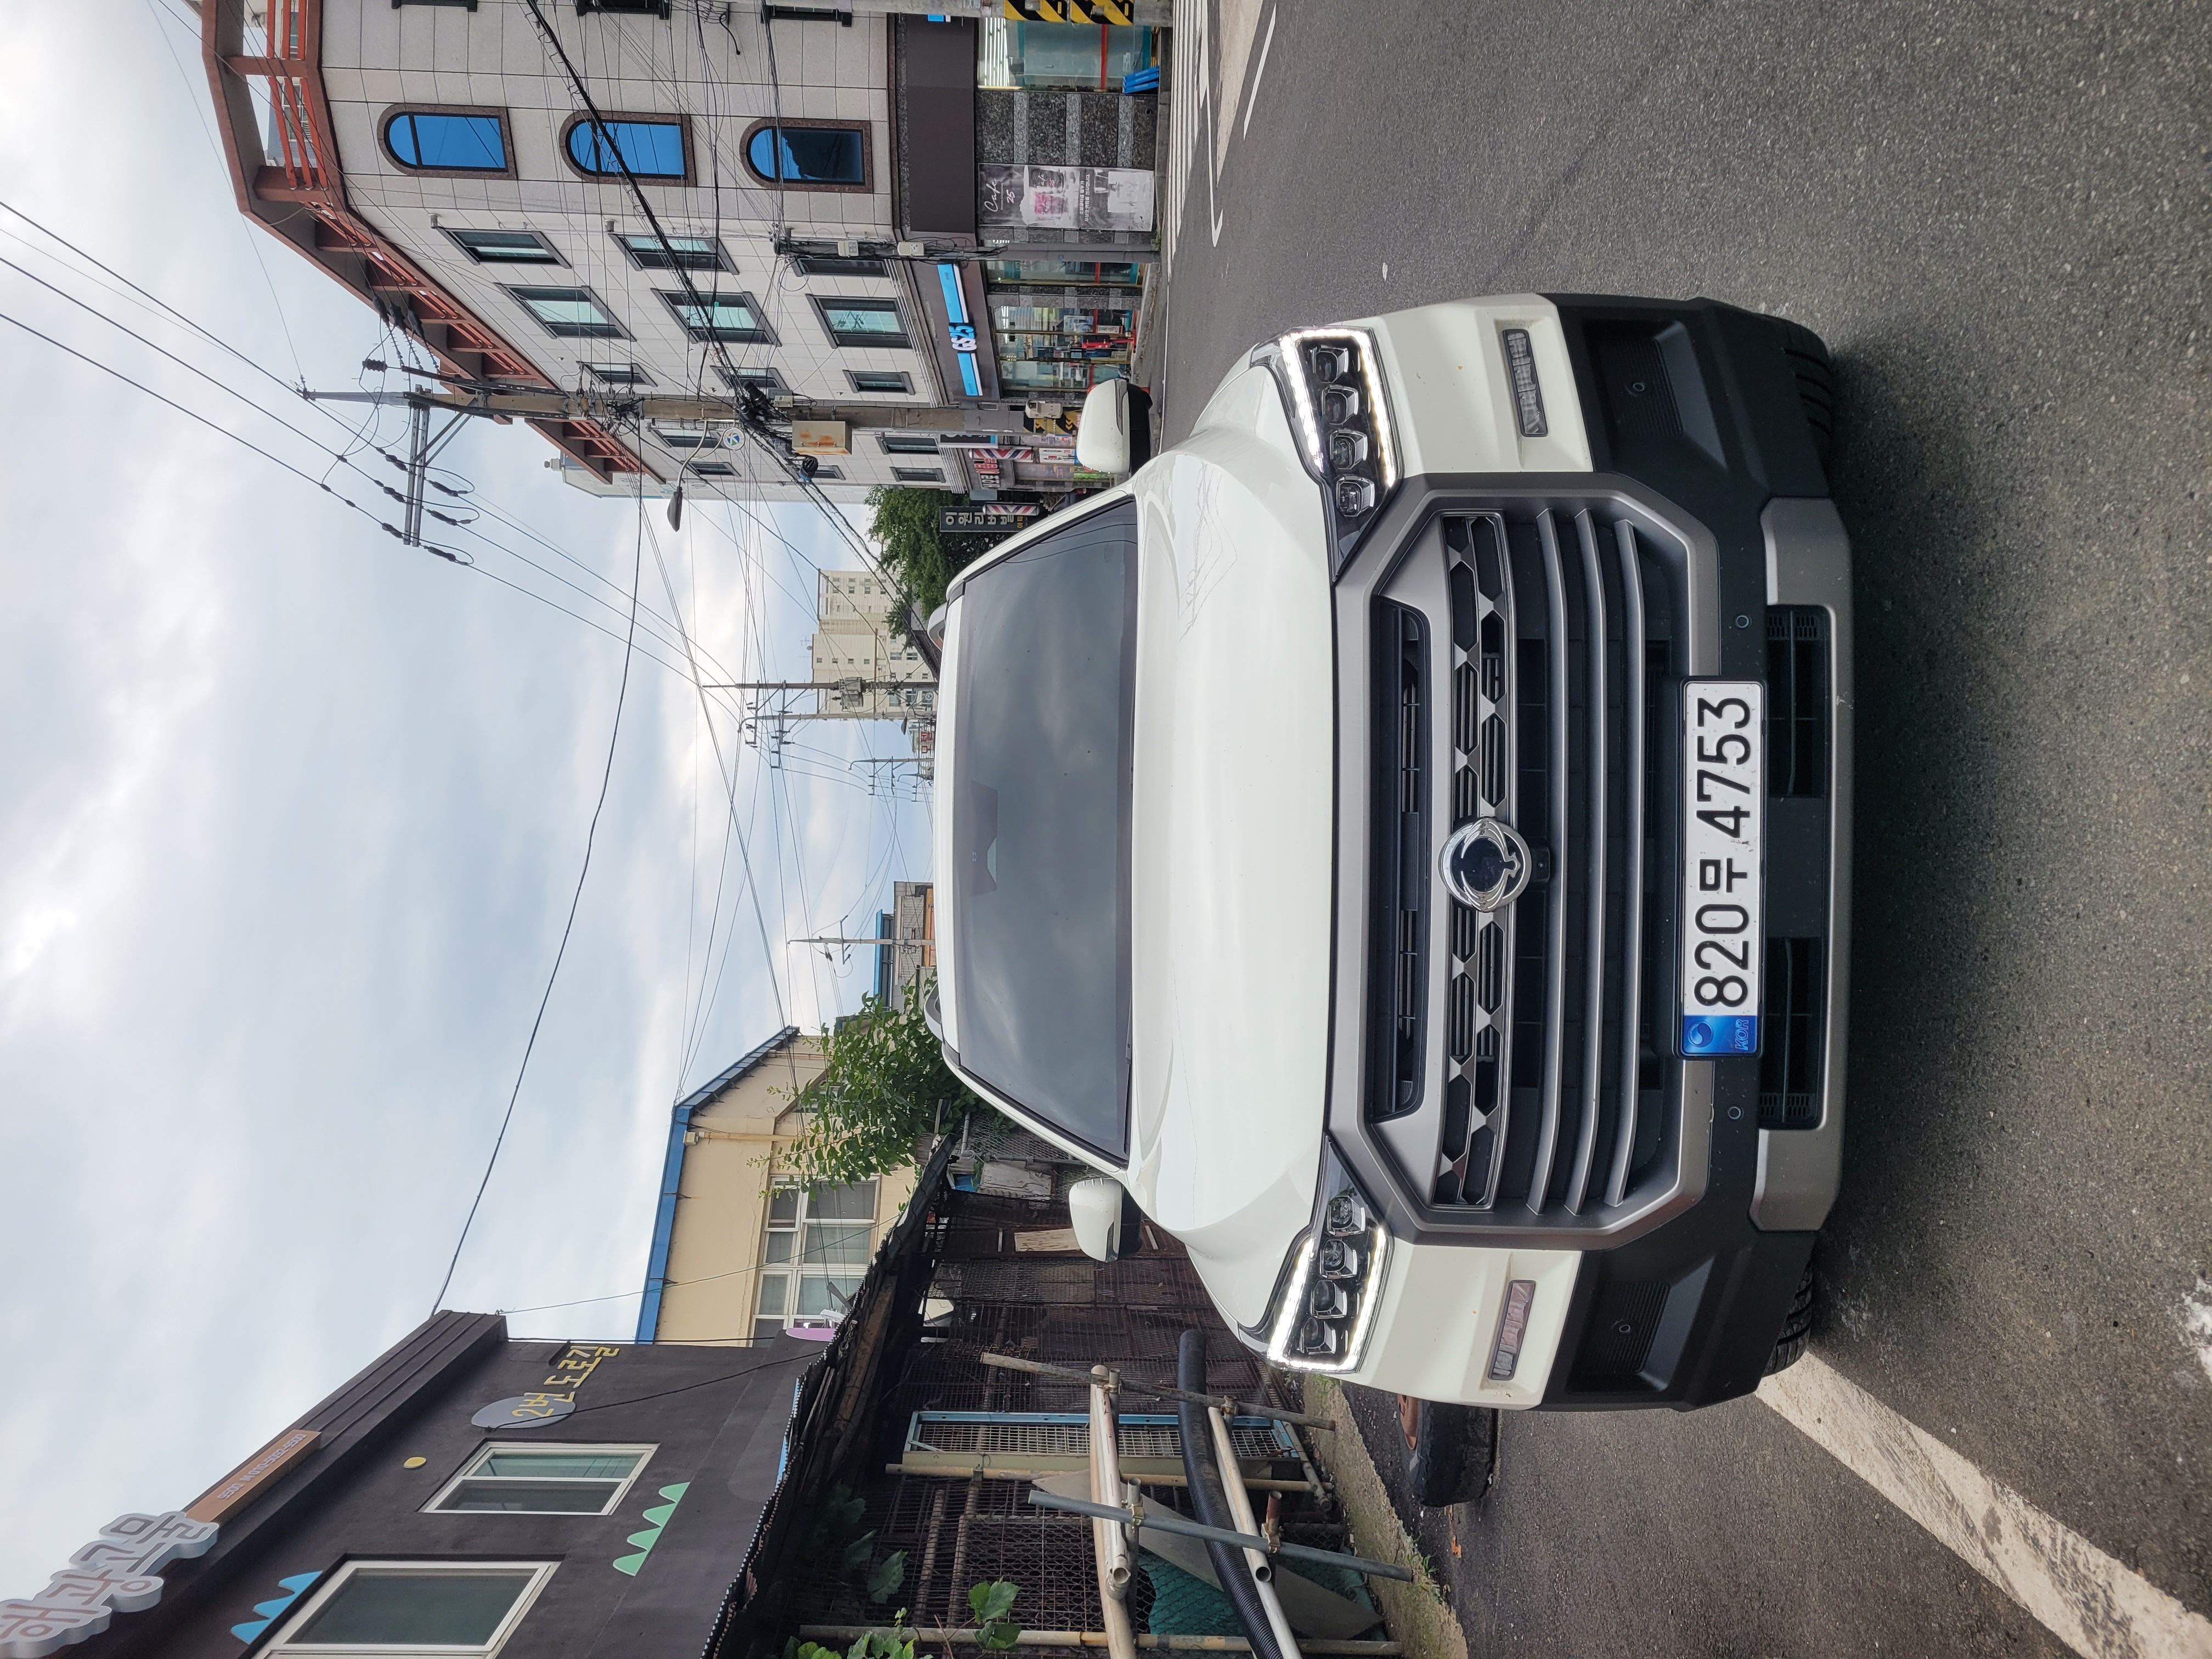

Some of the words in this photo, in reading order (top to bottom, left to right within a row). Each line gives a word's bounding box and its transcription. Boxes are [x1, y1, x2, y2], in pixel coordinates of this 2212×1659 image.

[1006, 189, 1015, 204] 25
[948, 325, 977, 351] GS25
[921, 732, 932, 753] 모텔
[1696, 697, 1751, 838] 4753
[1694, 857, 1749, 1007] 820무
[1735, 1018, 1749, 1051] KOR
[511, 1391, 575, 1417] 2번
[543, 1346, 619, 1388] 도로길
